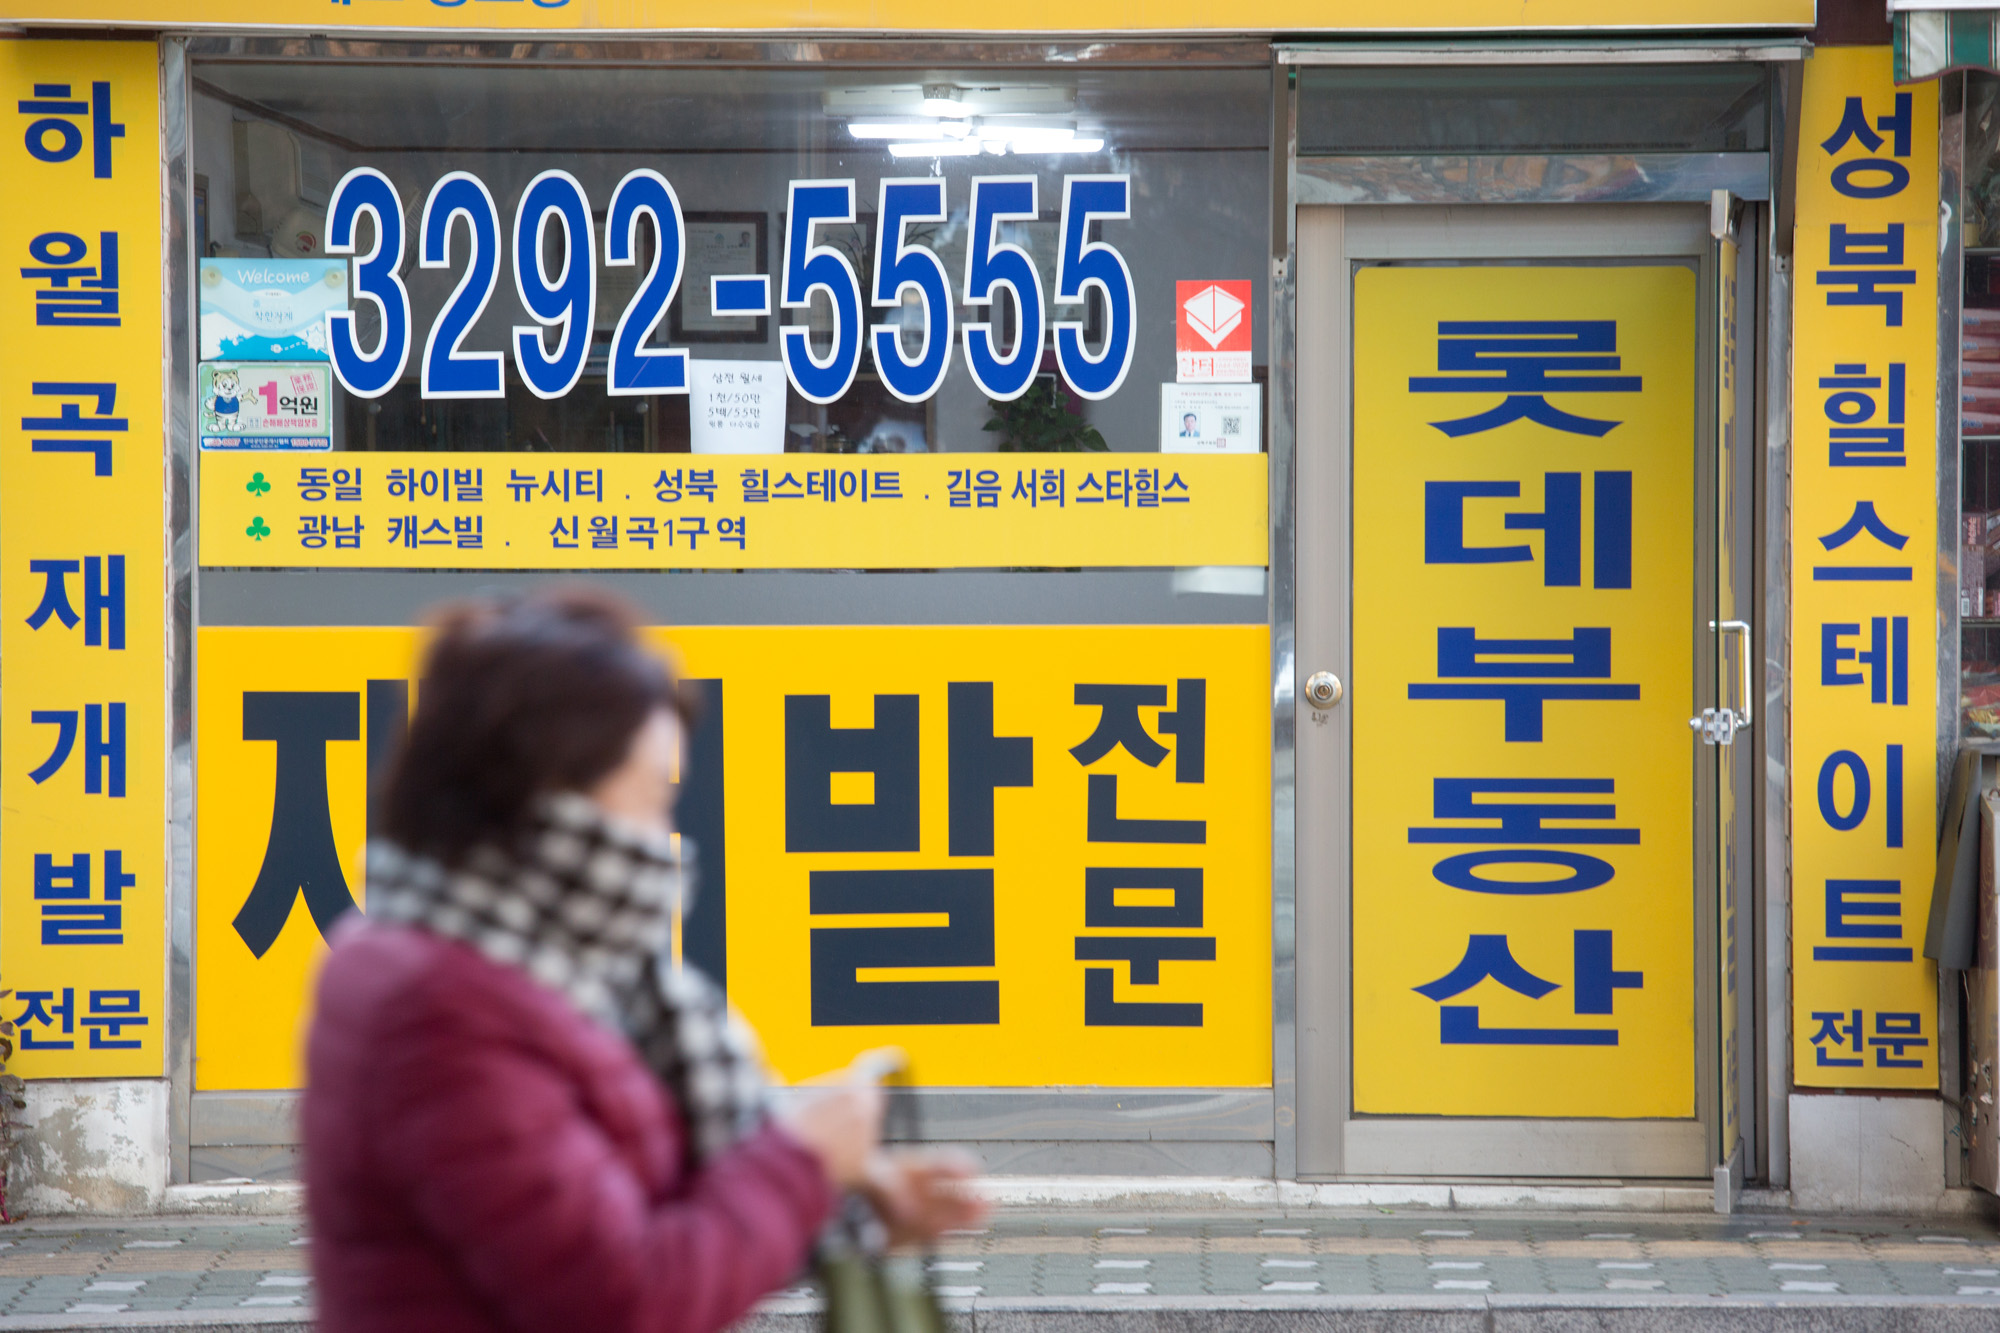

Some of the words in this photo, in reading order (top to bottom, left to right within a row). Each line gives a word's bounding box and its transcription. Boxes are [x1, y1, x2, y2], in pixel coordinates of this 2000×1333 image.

[19, 82, 128, 476] 하월곡
[237, 268, 310, 284] Welcome
[325, 167, 1138, 404] 3292-5555
[258, 381, 318, 415] 1억원
[298, 469, 361, 501] 동일
[387, 469, 482, 501] 하이빌
[507, 469, 602, 501] 뉴시티
[654, 470, 717, 502] 성북
[741, 470, 902, 502] 힐스테이트
[948, 470, 1001, 507] 길음
[1012, 470, 1064, 507] 서희
[1076, 469, 1189, 507] 스타힐스
[299, 516, 364, 548] 광남
[388, 516, 482, 548] 캐스빌
[551, 516, 745, 549] 신월곡1구역
[1814, 94, 1915, 961] 성북힐스테이트
[26, 555, 135, 944] 재개발
[1408, 321, 1642, 1045] 롯데부동산
[1069, 679, 1216, 1026] 전문
[14, 988, 148, 1049] 전문
[1811, 1010, 1927, 1067] 전문
